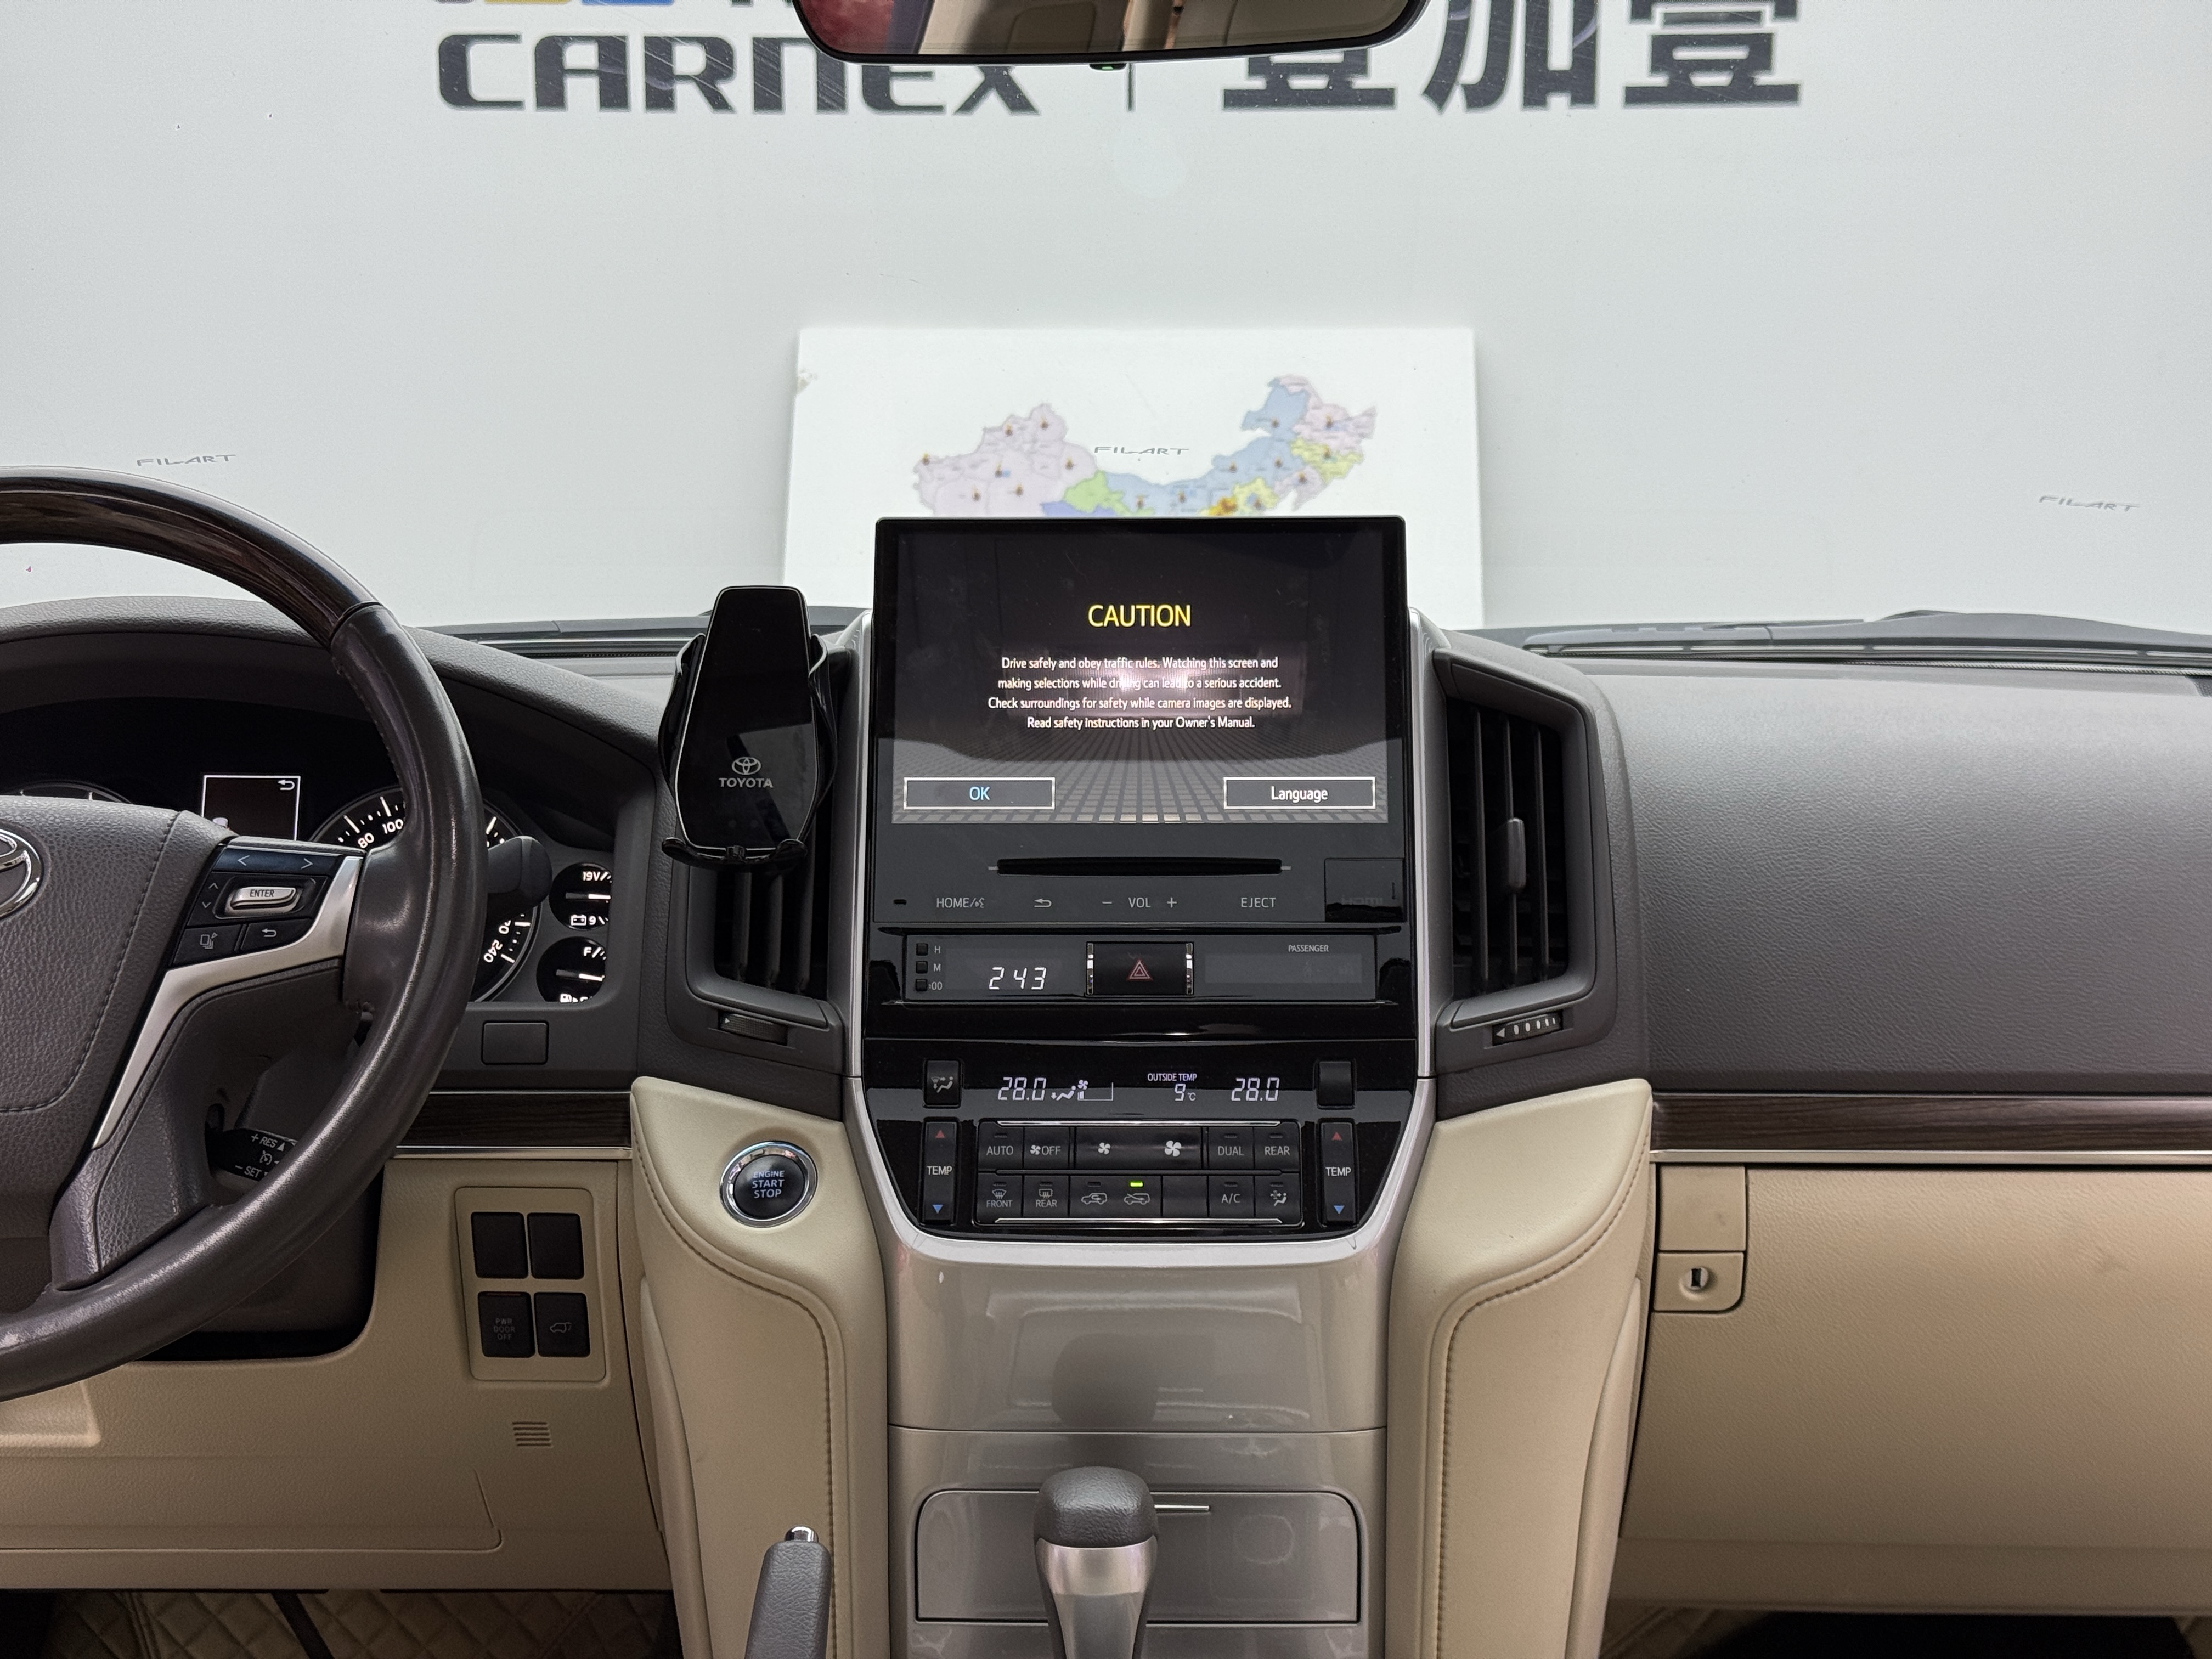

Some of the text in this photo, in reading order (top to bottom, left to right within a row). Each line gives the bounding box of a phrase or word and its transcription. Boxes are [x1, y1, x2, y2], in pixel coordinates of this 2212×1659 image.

[136, 454, 236, 467] FILART
[1088, 604, 1192, 627] CAUTION
[1001, 657, 1278, 670] Drive safely and obey traffic rules. Watching this screen and
[998, 677, 1032, 691] making
[1034, 677, 1080, 689] selections
[1082, 677, 1107, 689] while
[1143, 680, 1160, 689] can
[1161, 677, 1181, 689] lead
[1196, 680, 1203, 689] a
[1204, 677, 1237, 689] serious
[1239, 677, 1282, 689] accident.
[988, 696, 1292, 710] Check surroundings for safety while camera images are displayed.
[1027, 716, 1255, 730] Read safety instructions in your Owner's Manual.
[718, 777, 774, 789] TOYOTA
[969, 786, 991, 801] OK
[1271, 786, 1328, 803] Language
[382, 819, 404, 834] 100
[357, 832, 375, 849] 80
[250, 889, 275, 898] ENTER
[1128, 897, 1151, 908] VOL
[1240, 897, 1277, 908] EJECT
[589, 916, 596, 925] 9
[483, 939, 504, 963] 240
[583, 947, 592, 956] F
[934, 946, 941, 954] H
[1288, 944, 1329, 952] PASSENGER
[933, 963, 941, 972] M
[1147, 1073, 1198, 1081] OUTSIDE TEMP
[997, 1077, 1047, 1101] 28.0
[1231, 1077, 1280, 1101] 28.0
[986, 1145, 1014, 1155] AUTO
[1041, 1145, 1062, 1155] OFF
[1217, 1146, 1245, 1156] DUAL
[1265, 1146, 1290, 1156] REAR
[753, 1170, 785, 1178] ENGINE
[927, 1165, 952, 1176] TEMP
[1325, 1167, 1351, 1177] TEMP
[752, 1179, 785, 1189] START
[754, 1189, 782, 1199] STOP
[1221, 1192, 1241, 1204] A/C
[986, 1199, 1013, 1207] FRONT
[1035, 1199, 1057, 1207] REAR
